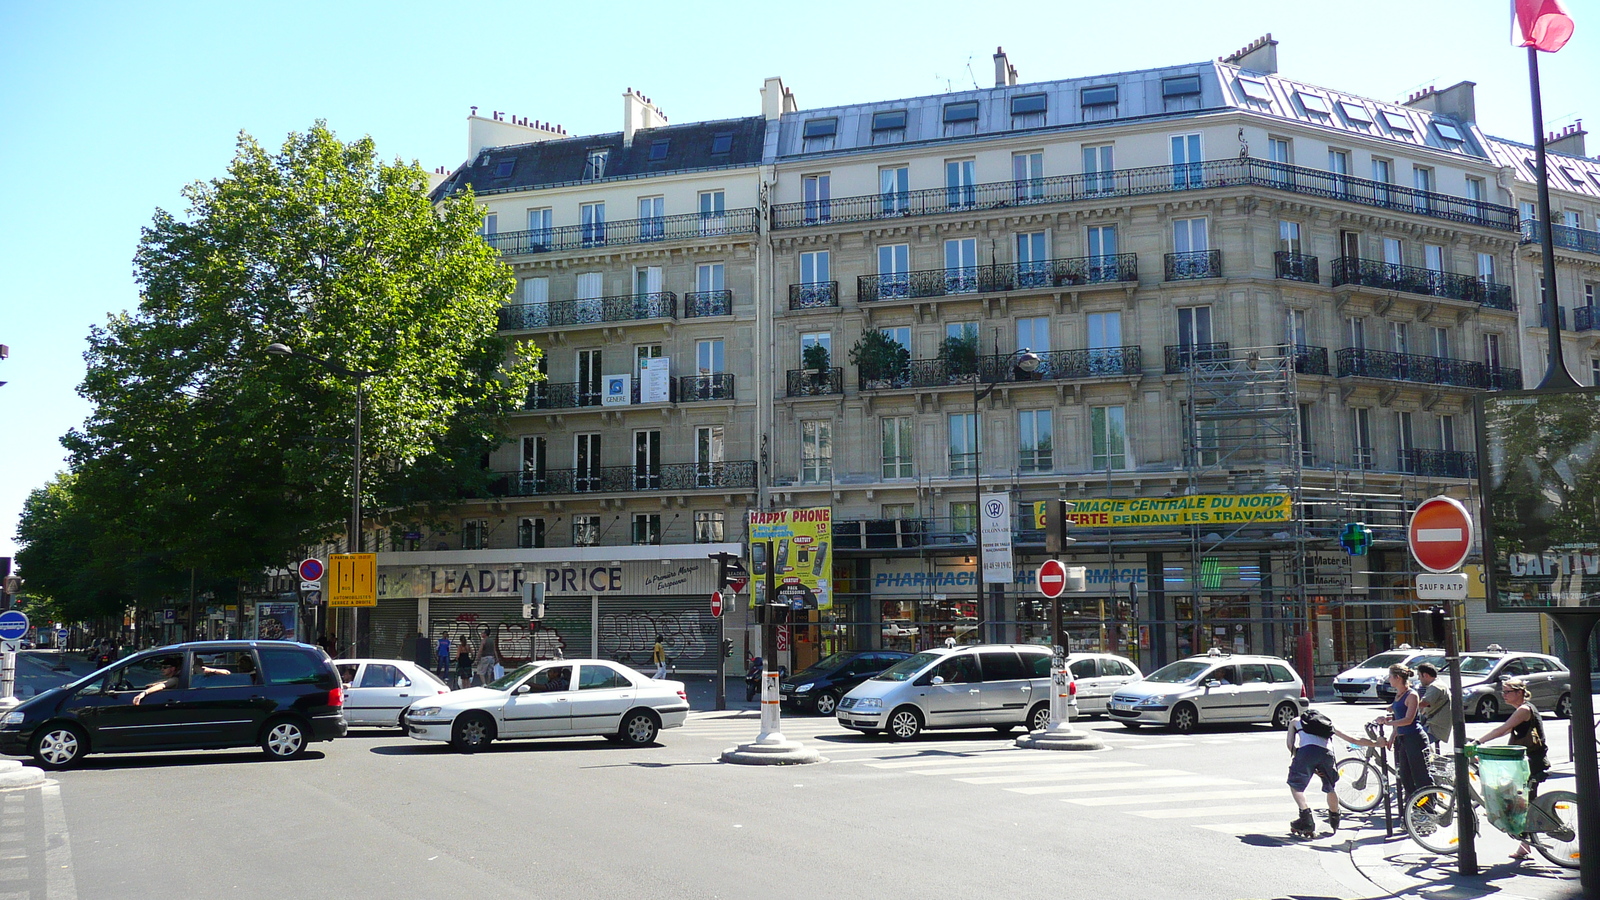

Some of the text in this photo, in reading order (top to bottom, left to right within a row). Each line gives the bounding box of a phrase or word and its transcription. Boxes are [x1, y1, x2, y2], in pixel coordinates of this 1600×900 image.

[1039, 496, 1283, 514] PRMACIE CENTRALE DU NORD
[751, 510, 830, 524] HAPPY PHONE
[1113, 514, 1178, 523] PENDANT
[1183, 512, 1209, 521] LES
[1213, 510, 1285, 520] TRAVAUX
[1314, 556, 1348, 565] Matérel
[430, 570, 527, 593] LEADER
[545, 568, 622, 591] PRICE
